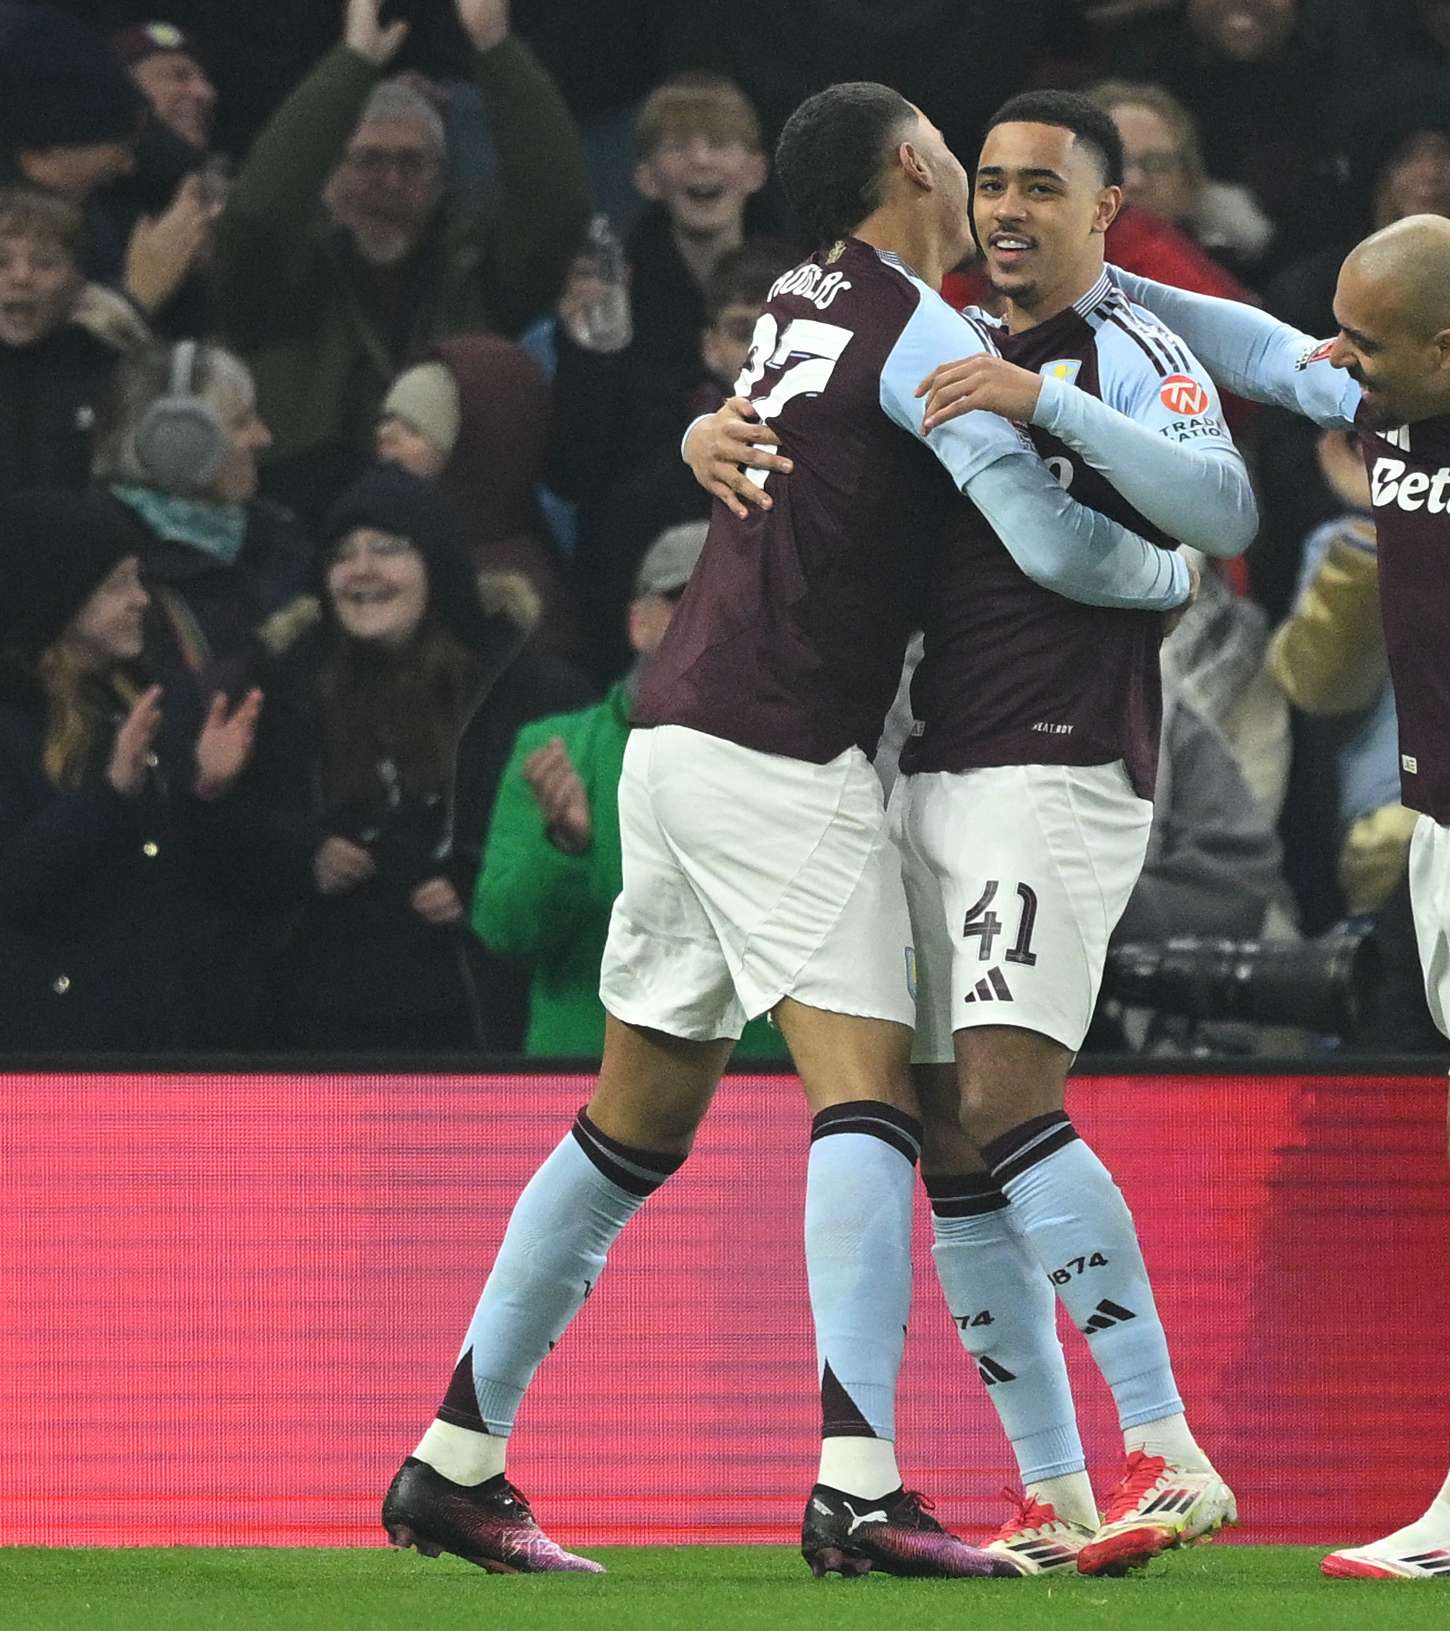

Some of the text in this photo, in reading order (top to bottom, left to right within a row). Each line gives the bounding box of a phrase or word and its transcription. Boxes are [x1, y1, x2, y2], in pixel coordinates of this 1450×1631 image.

[1170, 427, 1230, 443] ATIO
[963, 880, 1038, 966] 41
[953, 1310, 995, 1331] 74
